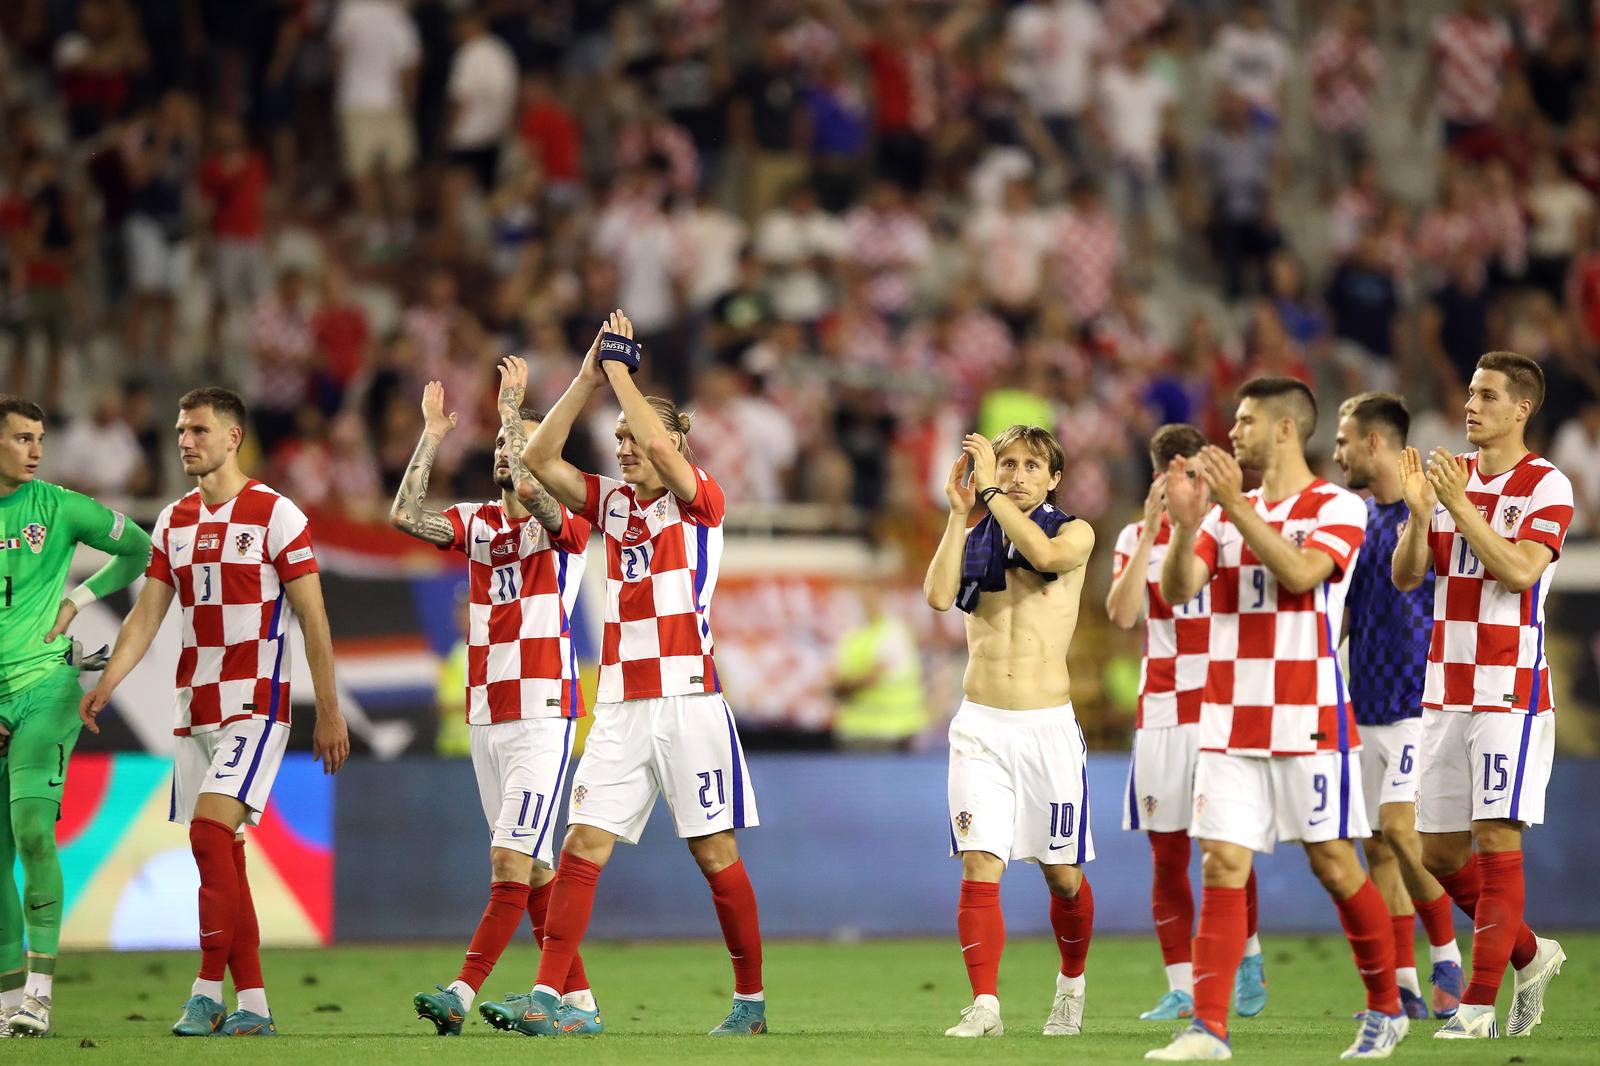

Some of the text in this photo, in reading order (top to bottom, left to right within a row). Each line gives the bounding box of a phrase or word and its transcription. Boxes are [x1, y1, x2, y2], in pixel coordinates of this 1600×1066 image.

[623, 545, 649, 579] 21
[4, 576, 12, 607] 1
[201, 566, 211, 601] 3
[496, 567, 516, 601] 11
[1252, 569, 1264, 608] 9
[58, 743, 64, 777] 1
[224, 736, 247, 768] 3
[1400, 745, 1414, 774] 6
[696, 769, 725, 808] 21
[1483, 753, 1508, 791] 15
[518, 791, 544, 829] 11
[1313, 774, 1327, 811] 9
[1049, 802, 1074, 837] 10
